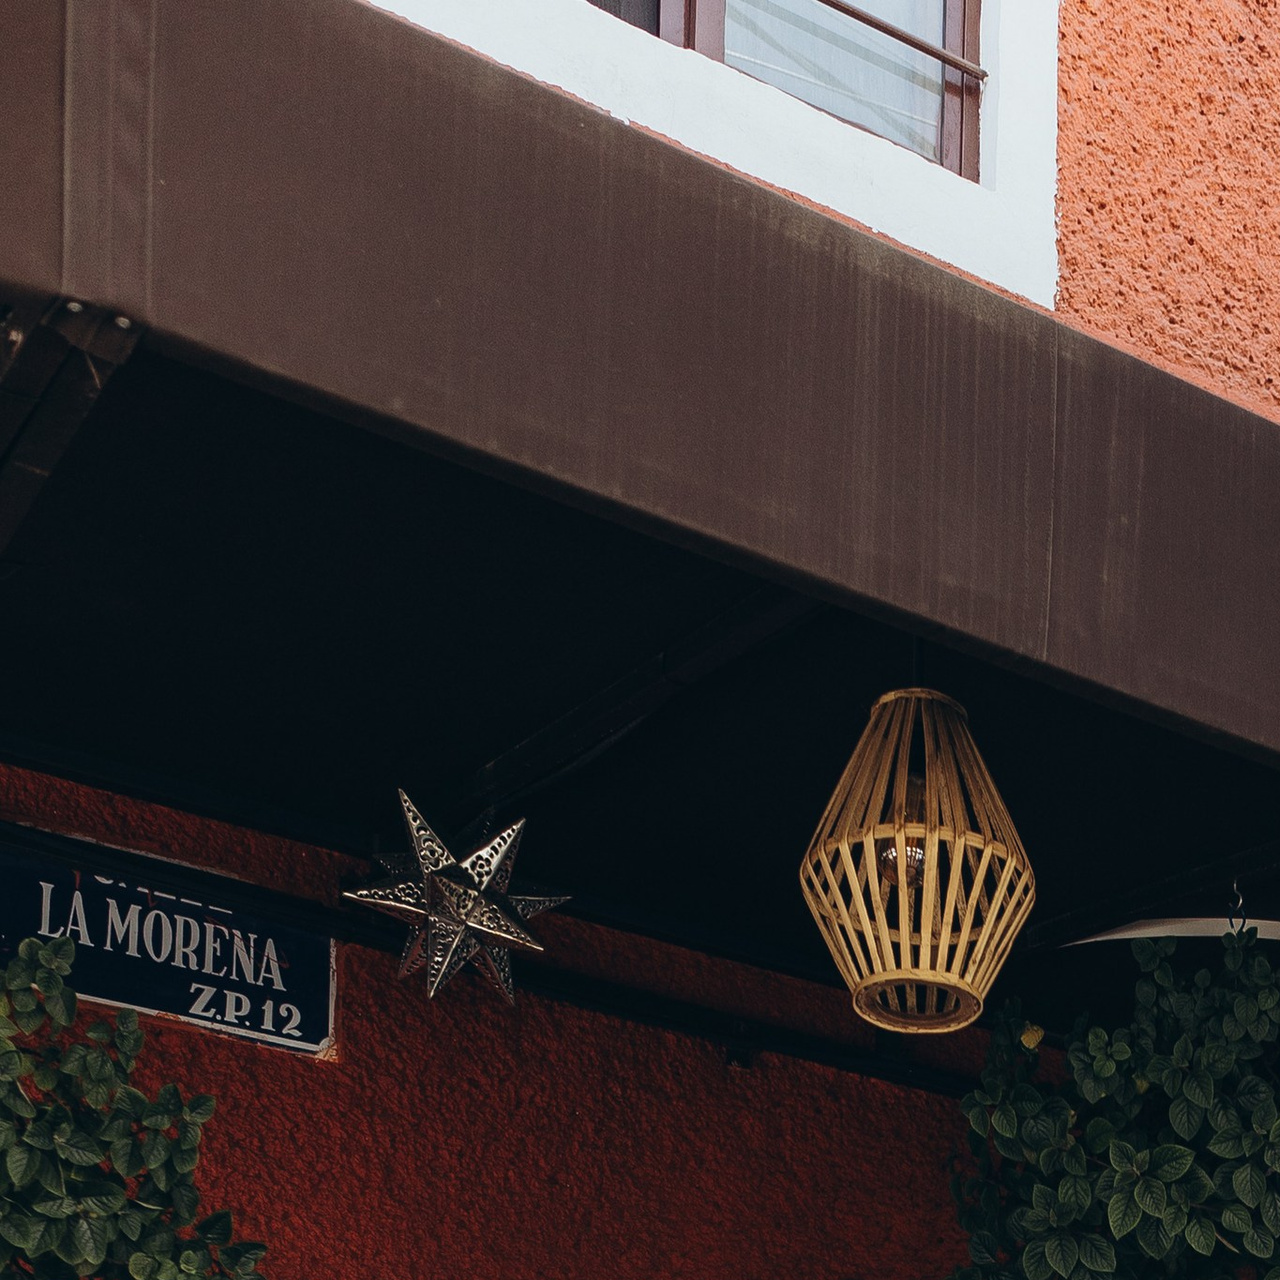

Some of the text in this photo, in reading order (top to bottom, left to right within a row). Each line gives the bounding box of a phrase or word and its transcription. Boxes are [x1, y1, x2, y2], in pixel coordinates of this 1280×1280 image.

[37, 881, 95, 947] LA
[103, 897, 287, 992] MORENA
[188, 982, 303, 1037] Z.P. 12
